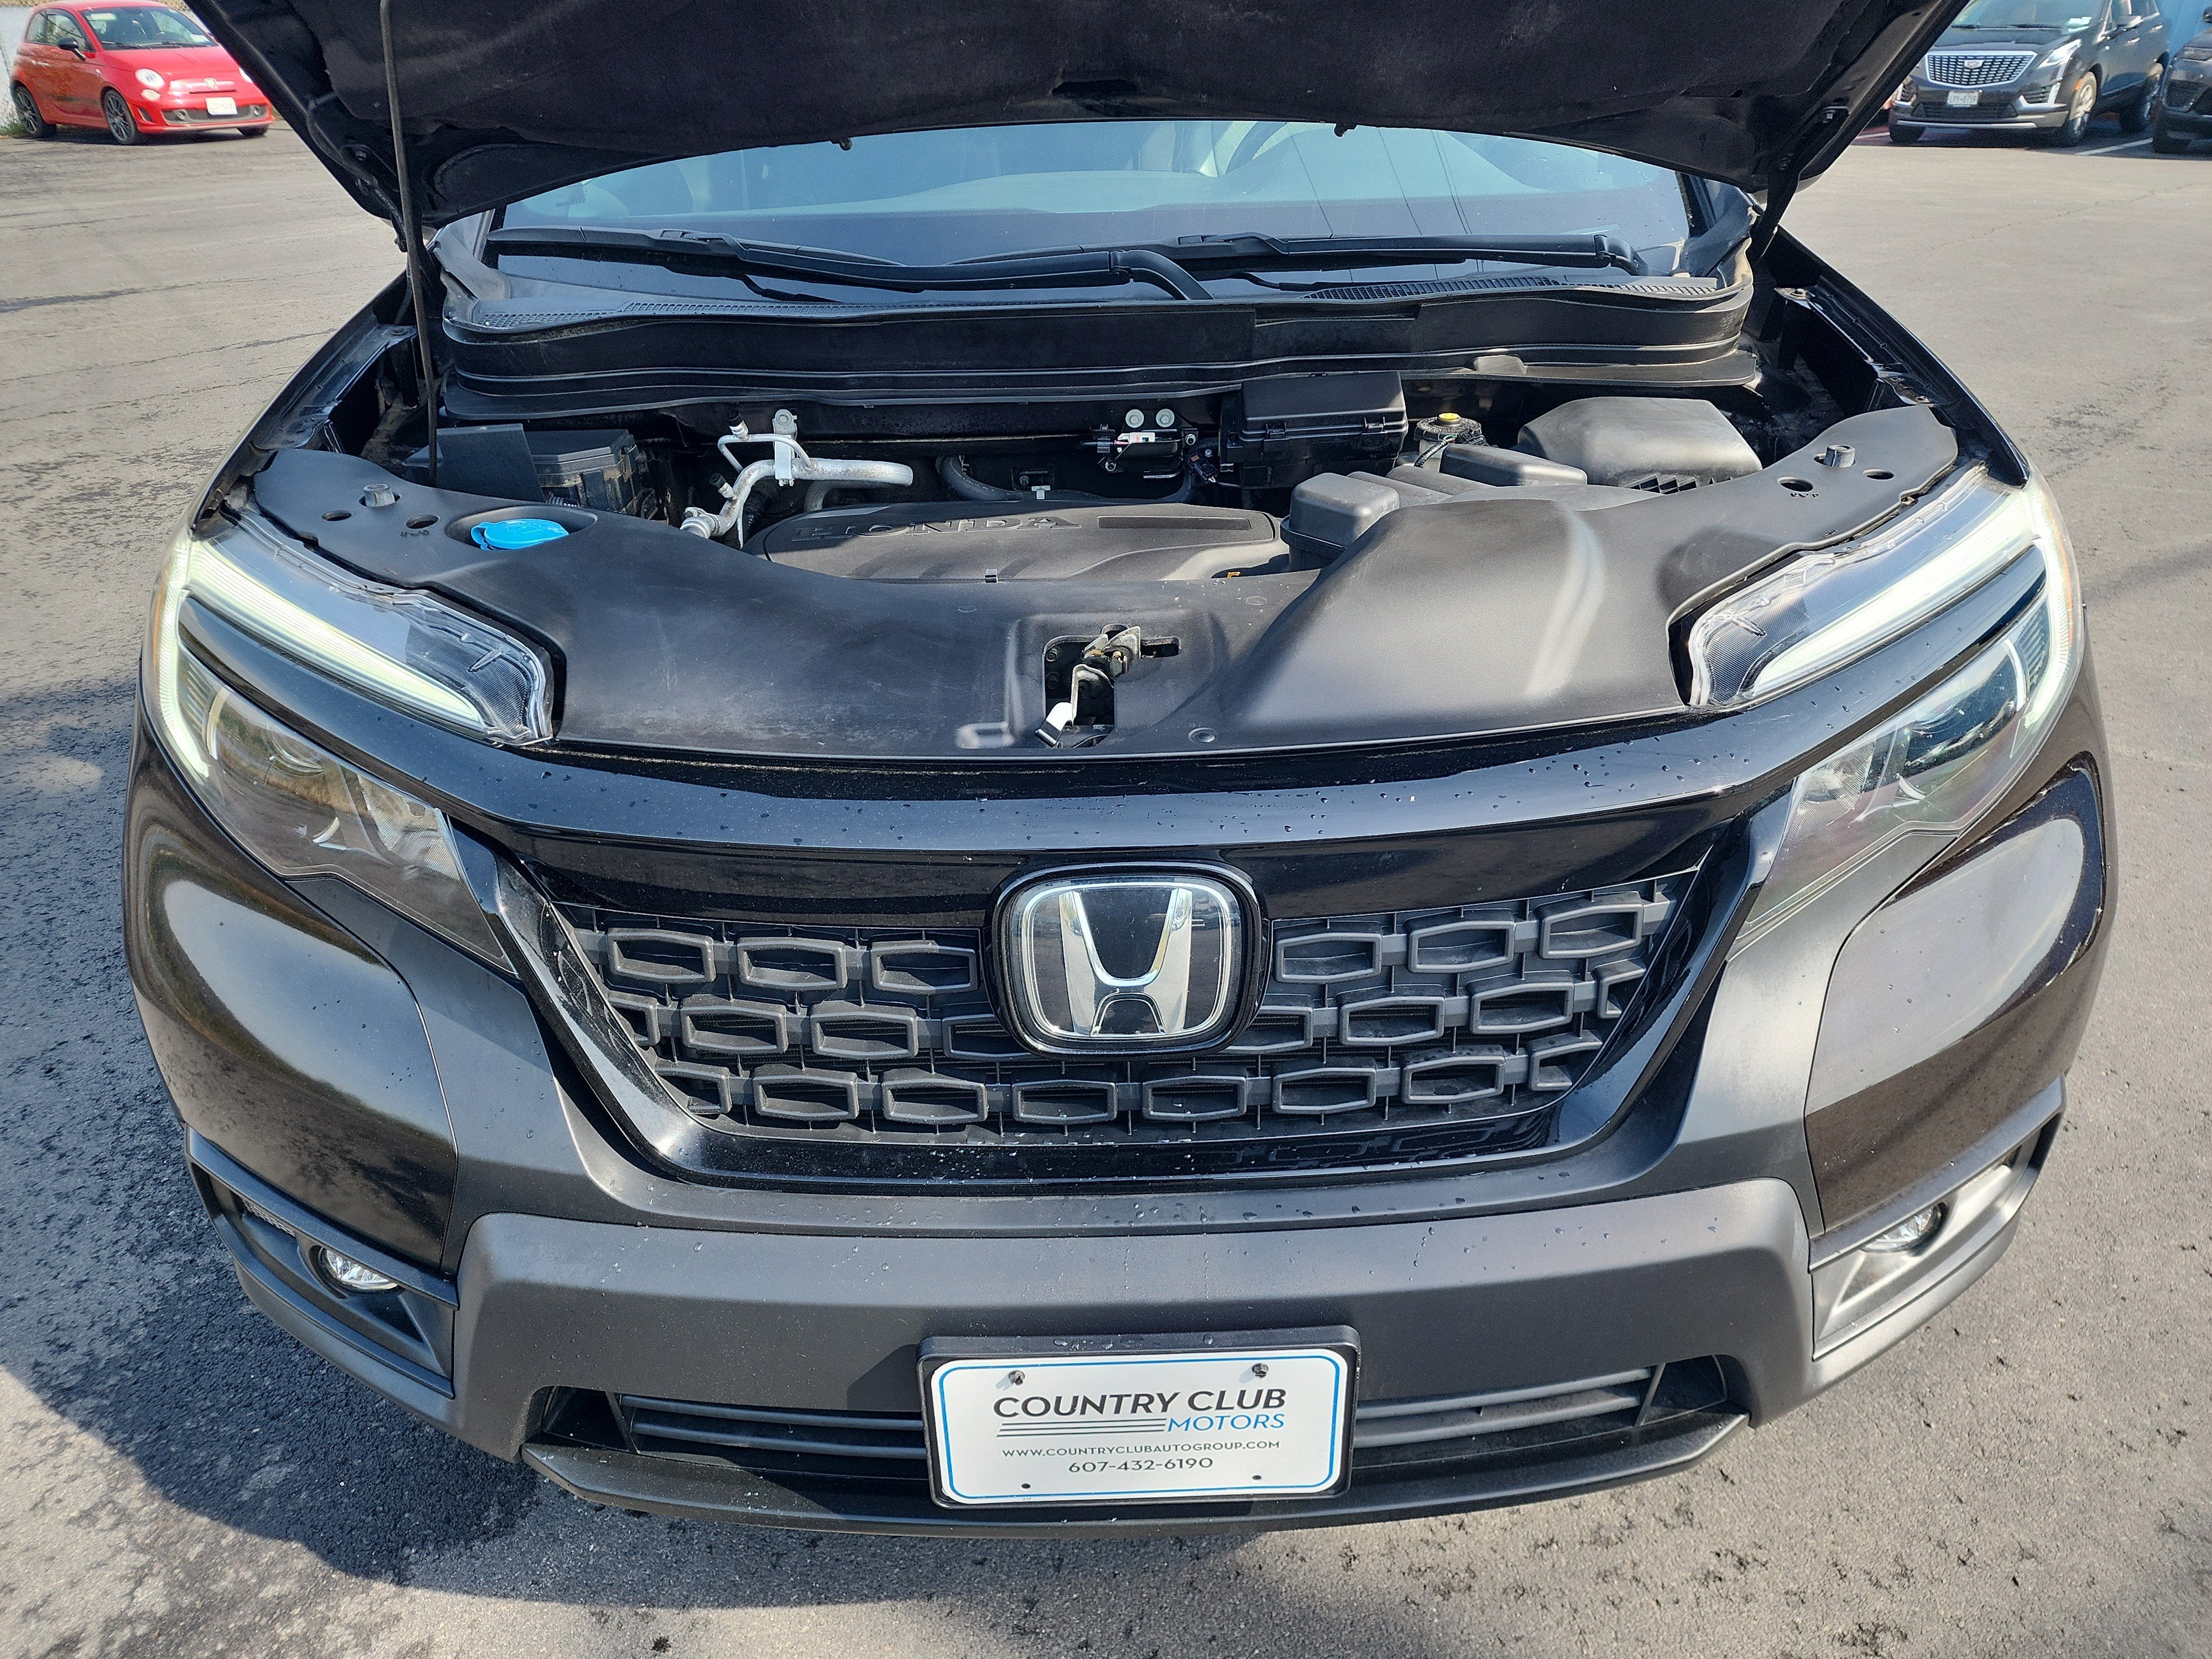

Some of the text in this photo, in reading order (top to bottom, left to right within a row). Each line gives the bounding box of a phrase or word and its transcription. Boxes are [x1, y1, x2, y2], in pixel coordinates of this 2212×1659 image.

[791, 516, 1081, 542] HONDA
[993, 1389, 1286, 1417] COUNTRY CLUB
[1167, 1413, 1285, 1432] MOTORS
[1002, 1441, 1280, 1457] WWW.COUNTRYCLUBAUTOGROUP.COM
[1068, 1458, 1213, 1473] 607-432-6190
